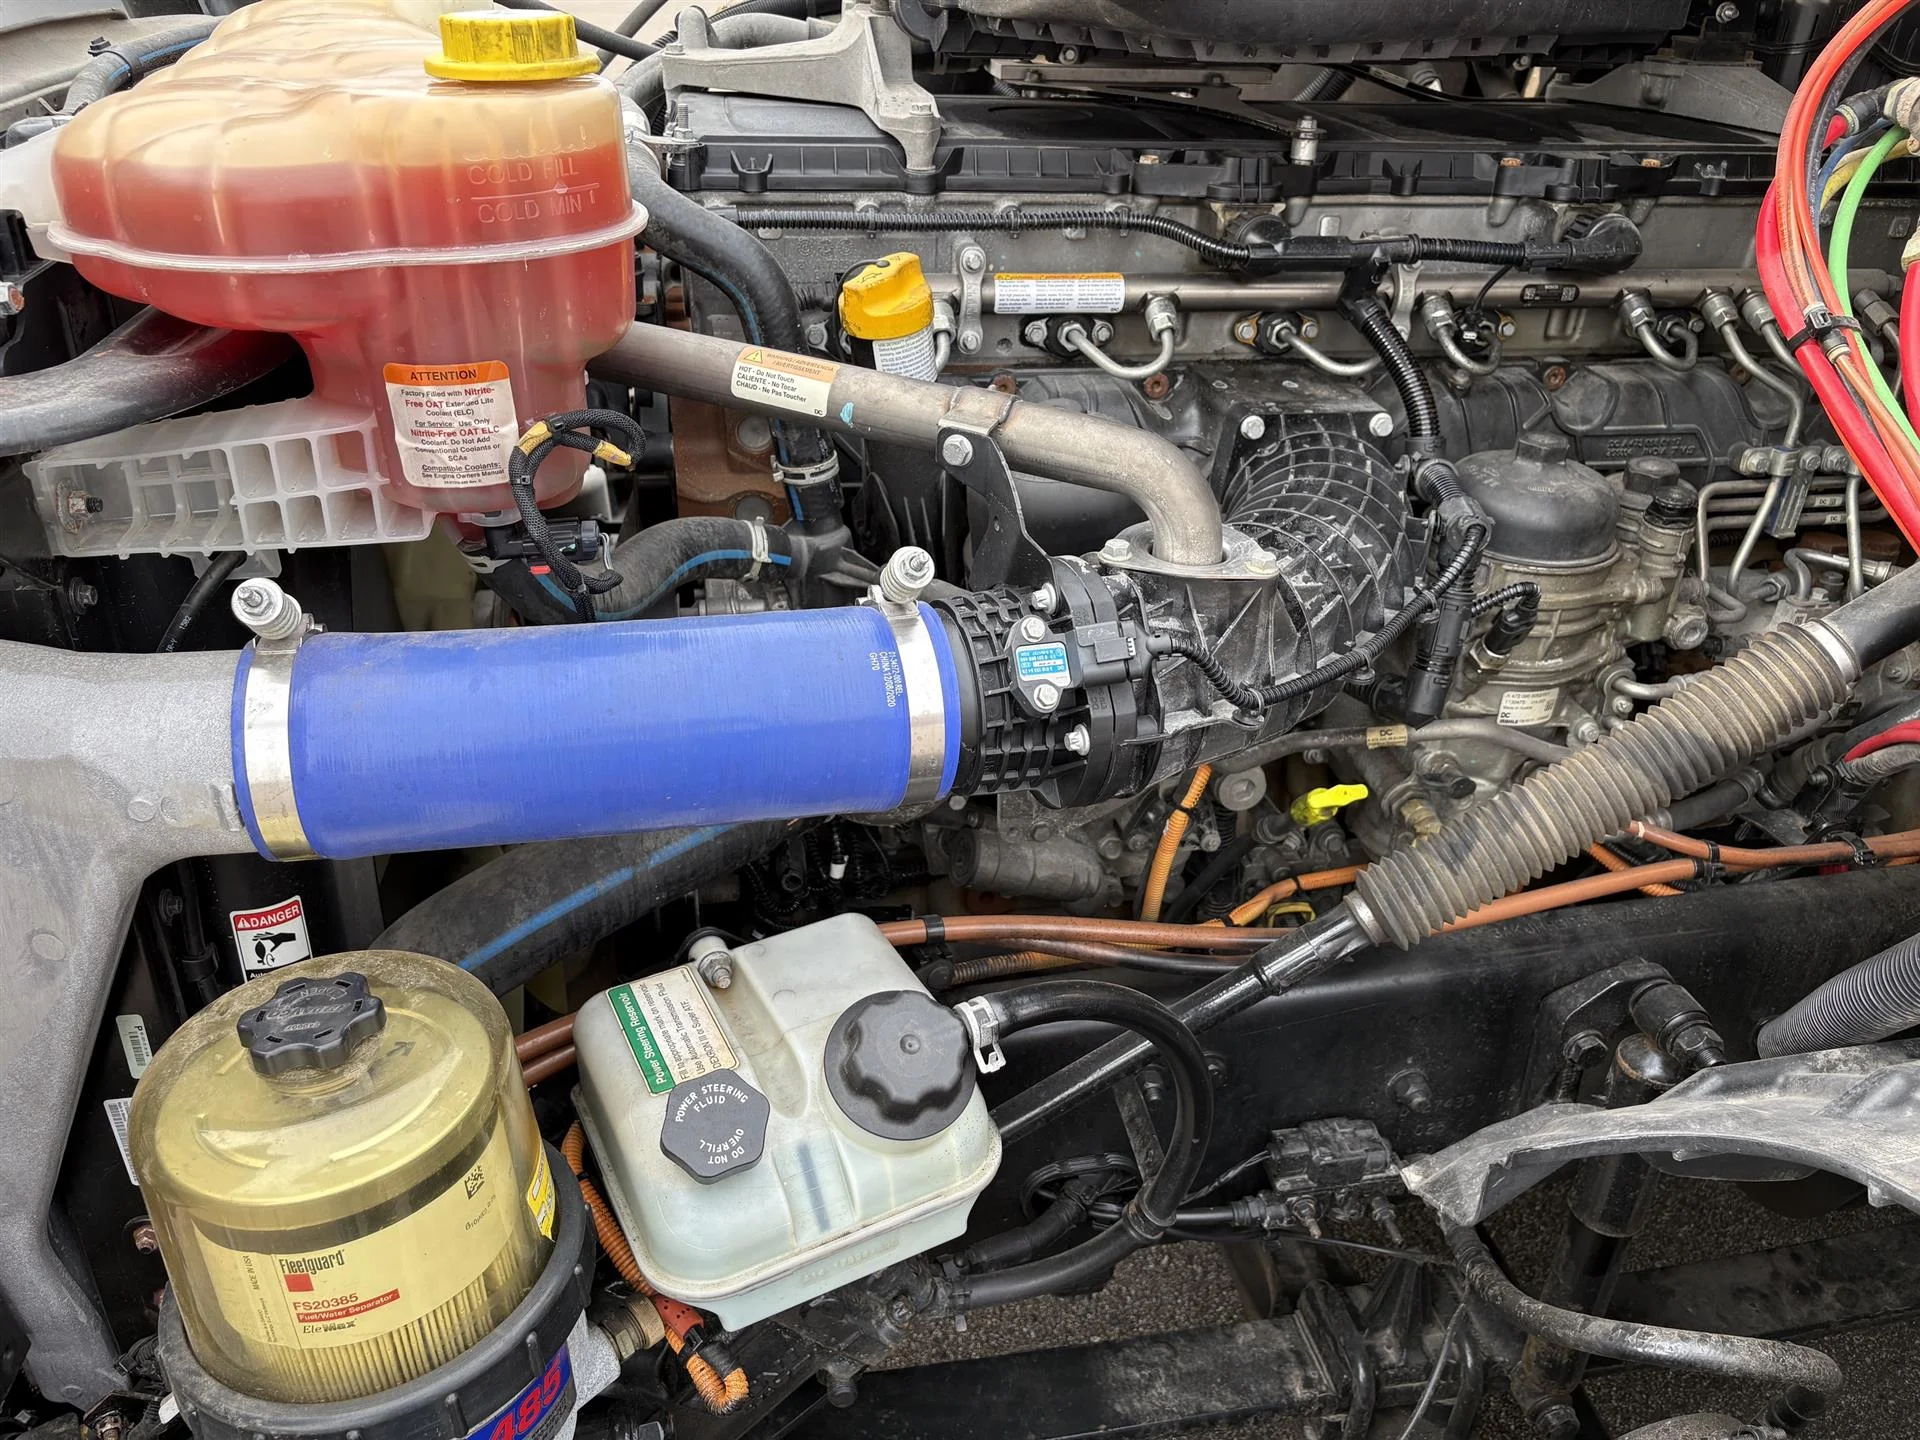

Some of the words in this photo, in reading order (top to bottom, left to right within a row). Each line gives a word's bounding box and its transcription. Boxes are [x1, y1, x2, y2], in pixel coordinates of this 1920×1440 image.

[467, 163, 533, 185] COLD
[543, 157, 579, 180] FILL
[478, 199, 540, 224] COLD
[550, 193, 583, 217] MIN
[410, 369, 478, 381] ATTENTION
[737, 372, 767, 385] CALIENTE
[781, 384, 798, 392] Tocar
[738, 365, 752, 374] HOT
[766, 371, 777, 380] Not
[777, 374, 795, 384] Touch
[400, 389, 425, 398] Factory
[464, 387, 496, 397] Nitrite-
[762, 386, 771, 394] Ne
[772, 389, 782, 397] Pas
[783, 391, 808, 403] Toucher
[405, 400, 424, 409] Free
[425, 400, 444, 409] OAT
[445, 399, 479, 408] Extended
[454, 408, 475, 418] (ELC)
[410, 429, 458, 439] Nitrite-Free
[459, 428, 480, 438] OAT
[481, 425, 500, 434] ELC
[428, 420, 455, 428] Service:
[473, 418, 491, 427] Only
[415, 446, 460, 455] Conventional
[460, 445, 492, 454] Coolants
[422, 464, 462, 473] Compatible
[464, 462, 502, 472] Coolants:
[434, 472, 456, 480] Engine
[456, 472, 481, 480] Owners
[481, 470, 505, 478] Manual
[870, 652, 880, 670] GH70
[880, 652, 891, 673] CHINA
[250, 904, 300, 928] DANGER
[656, 982, 668, 997] Fluid
[618, 992, 641, 1027] Reservoir
[650, 1006, 660, 1016] on
[663, 996, 684, 1033] Transmission
[655, 1014, 666, 1030] mark
[687, 1010, 701, 1030] Super
[696, 1028, 704, 1036] or
[636, 1026, 656, 1059] Steering
[662, 1030, 683, 1062] appropriate
[680, 1031, 700, 1061] Automatic
[702, 1041, 722, 1070] DEXRON
[650, 1059, 667, 1084] Power
[676, 1061, 686, 1070] to
[680, 1069, 690, 1080] Fill
[695, 1060, 706, 1075] Use
[675, 1092, 698, 1122] POWER
[701, 1084, 749, 1104] STEERING
[694, 1095, 726, 1112] FLUID
[700, 1128, 744, 1153] OVERFILL
[708, 1154, 728, 1165] NOT
[731, 1146, 745, 1159] DO
[279, 1250, 345, 1275] Fleetguard
[292, 1292, 359, 1312] FS20385
[299, 1309, 346, 1322] Fuel/Water
[348, 1292, 394, 1314] Separator
[490, 1358, 561, 1440] 485
